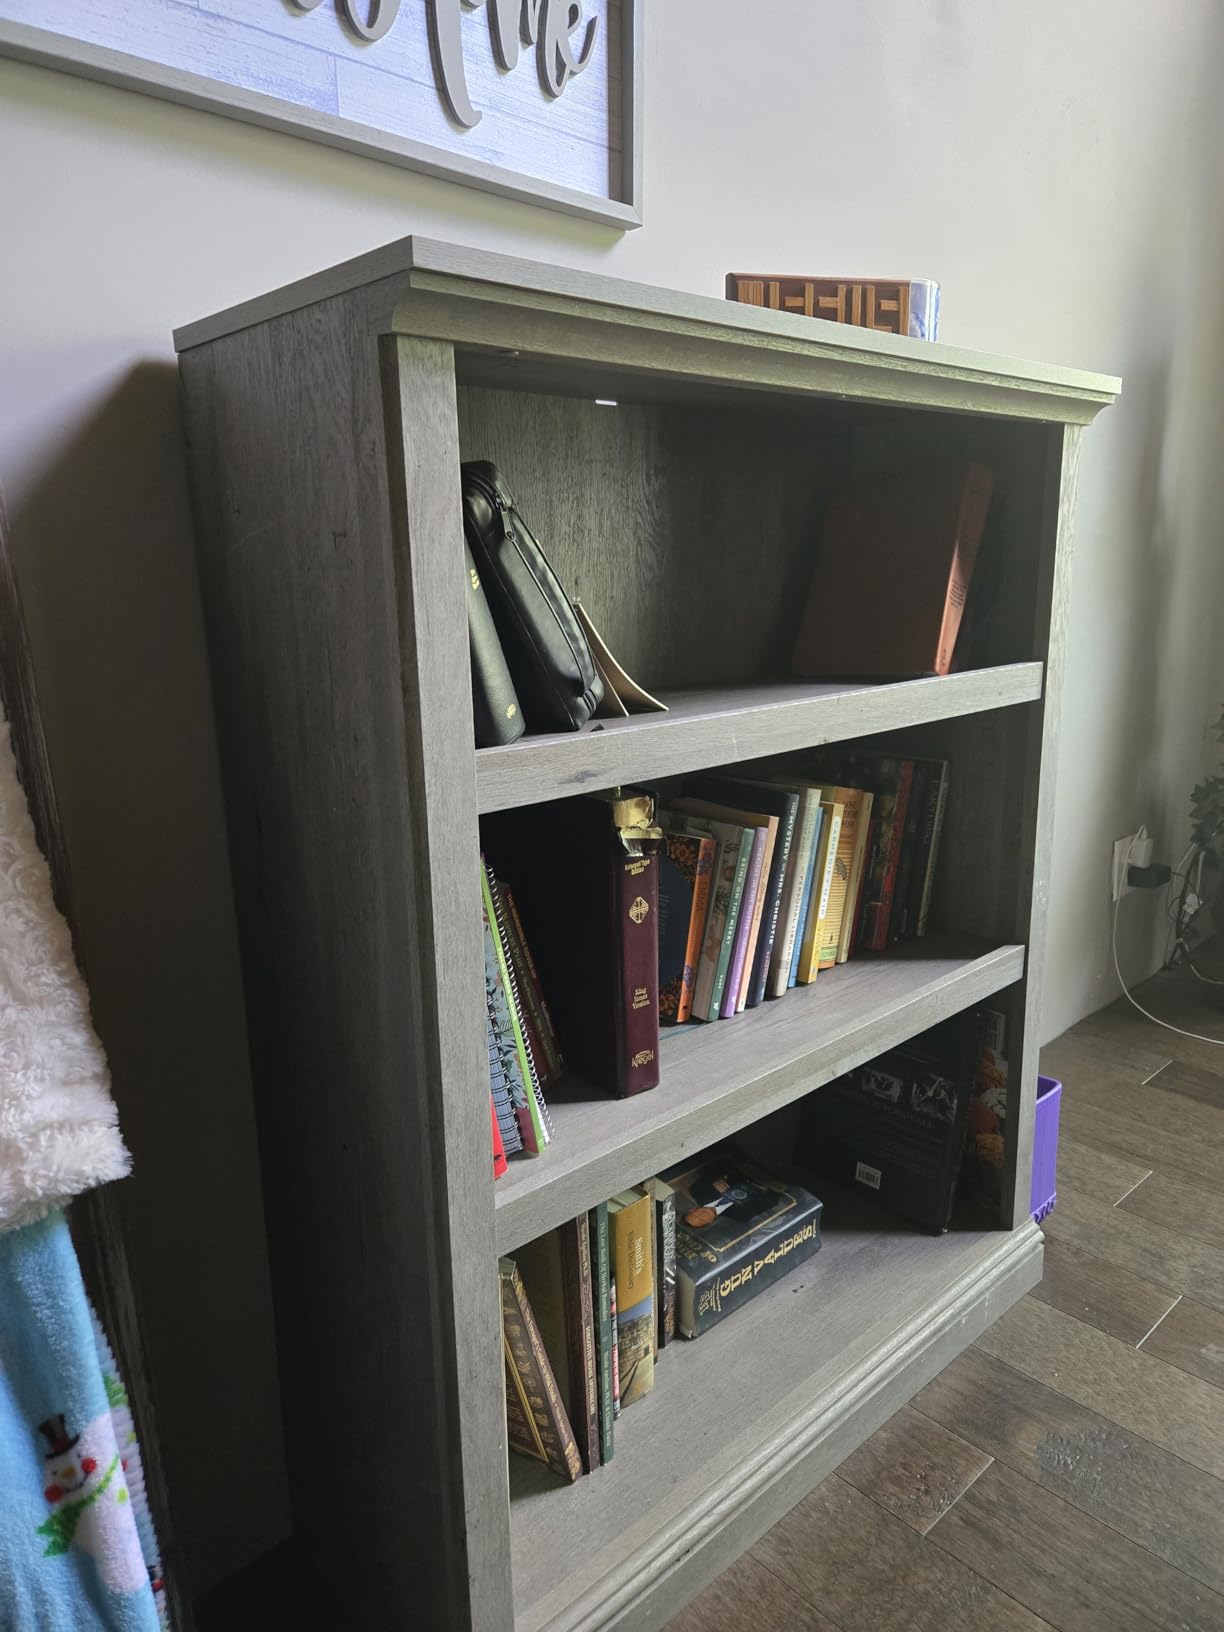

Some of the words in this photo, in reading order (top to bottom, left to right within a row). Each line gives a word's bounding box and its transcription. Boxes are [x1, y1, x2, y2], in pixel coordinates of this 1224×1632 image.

[781, 815, 795, 860] MYSTERY
[825, 820, 838, 883] CARNEGIE'S
[736, 857, 746, 882] BRING
[776, 873, 784, 897] MRS.
[506, 893, 514, 906] THE
[730, 902, 738, 915] THE
[733, 886, 740, 898] ON
[792, 875, 803, 922] PERSONAL
[820, 888, 828, 915] MAID
[724, 919, 734, 945] MERRY
[768, 899, 780, 944] CHRISTIE
[783, 925, 795, 973] LIBRARIAN
[626, 1249, 635, 1290] Dictionary
[635, 1237, 643, 1277] Smith's
[720, 1265, 753, 1297] GUN
[754, 1225, 813, 1276] VALUES
